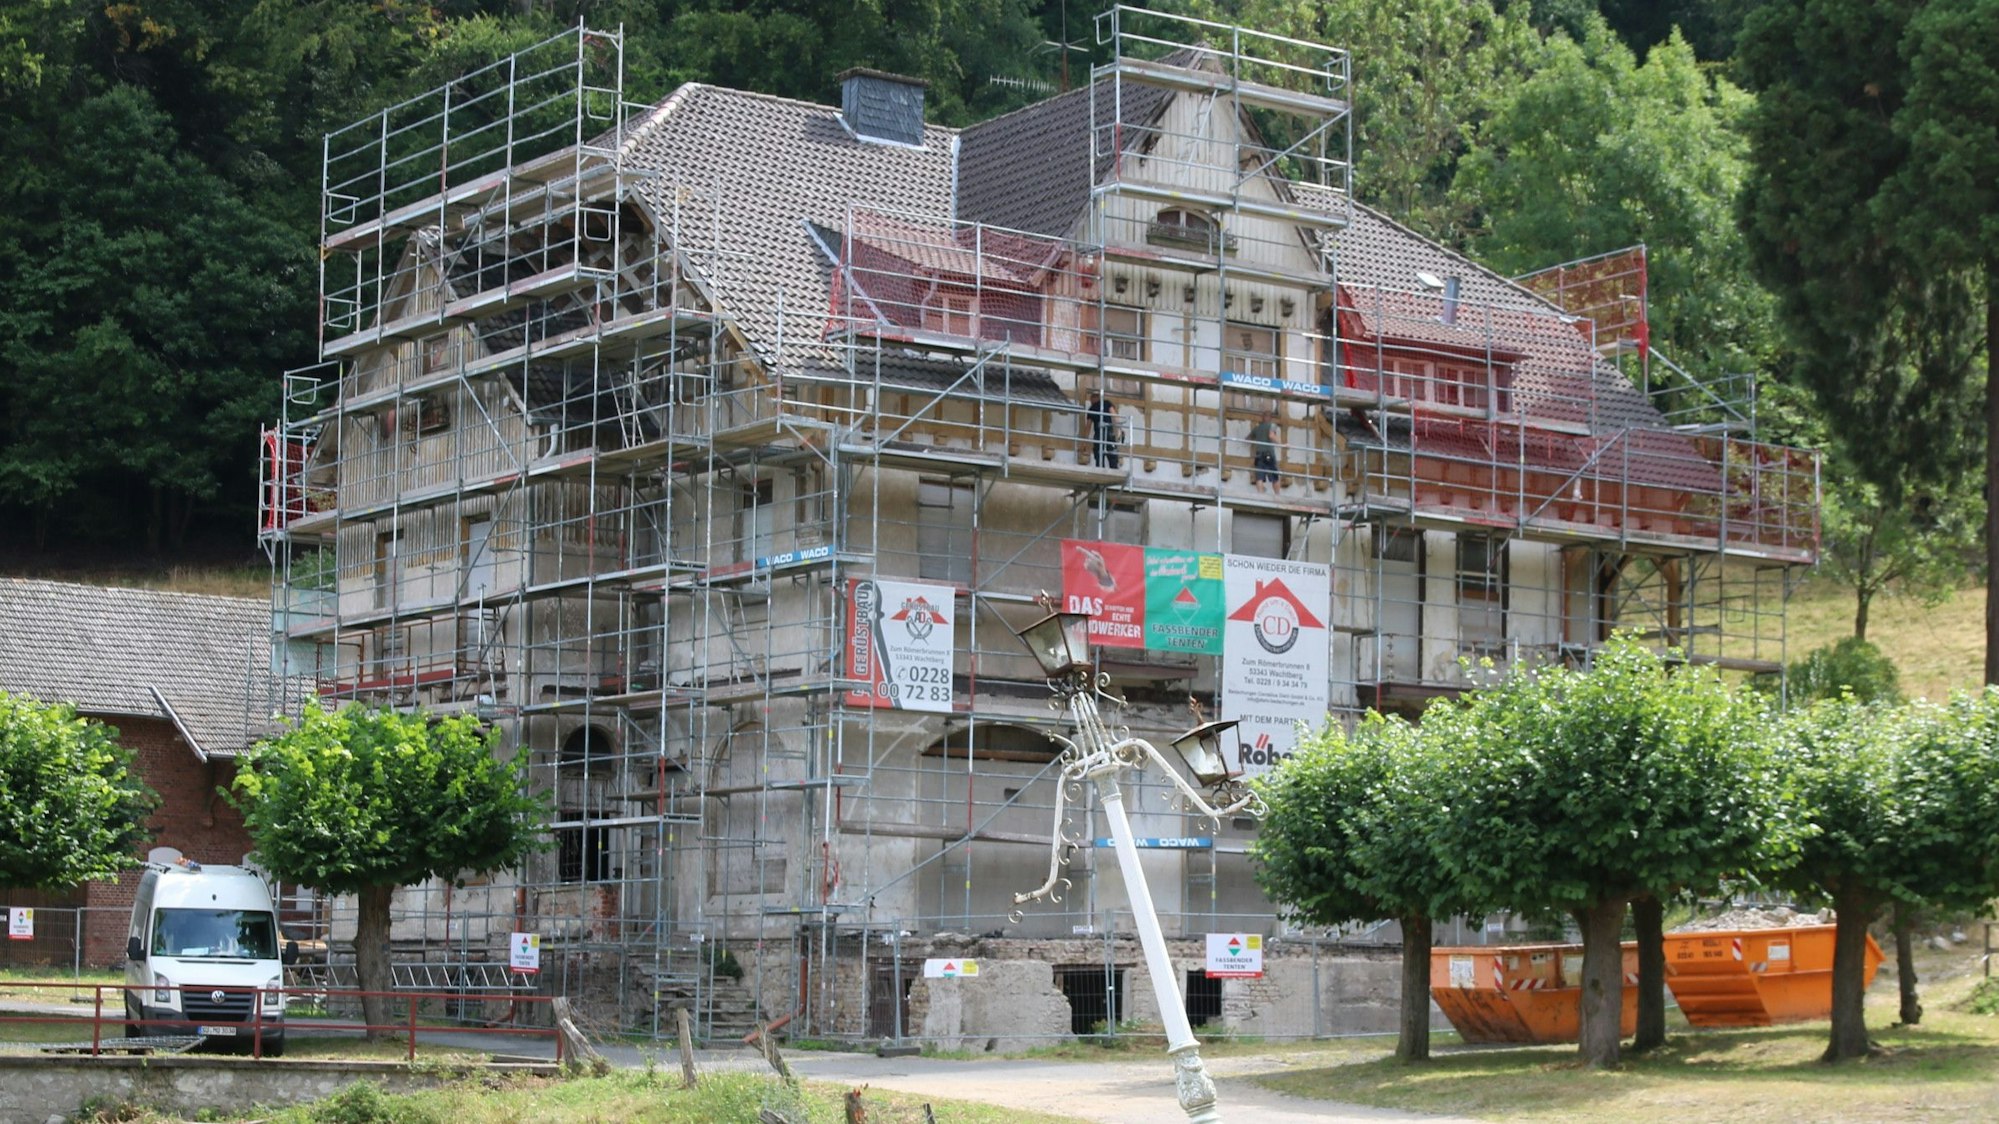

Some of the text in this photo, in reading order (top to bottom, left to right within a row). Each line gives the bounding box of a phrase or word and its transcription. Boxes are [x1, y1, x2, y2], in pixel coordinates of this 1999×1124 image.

[1232, 373, 1320, 393] WACO WACO
[766, 546, 828, 566] WACO WACO
[1227, 559, 1254, 570] SCHON
[1256, 562, 1287, 573] WIEDER
[1288, 565, 1300, 574] DIE
[1303, 567, 1326, 576] FIRMA
[1068, 595, 1103, 616] DAS
[1111, 612, 1131, 622] ECHTE
[1263, 615, 1290, 636] CD
[852, 591, 870, 675] GERÜSTBAU
[1152, 623, 1218, 637] FASSBENDER
[1167, 637, 1206, 649] TENTEN
[1242, 658, 1256, 666] Zum
[1257, 659, 1304, 670] Römerbrunnen
[909, 666, 949, 684] 0228
[1269, 669, 1303, 681] Wachtberg
[879, 683, 899, 697] 00
[905, 684, 925, 700] 72
[930, 686, 950, 702] 83
[1241, 714, 1253, 723] MIT
[1255, 715, 1272, 724] DEM
[1159, 838, 1200, 847] WACO
